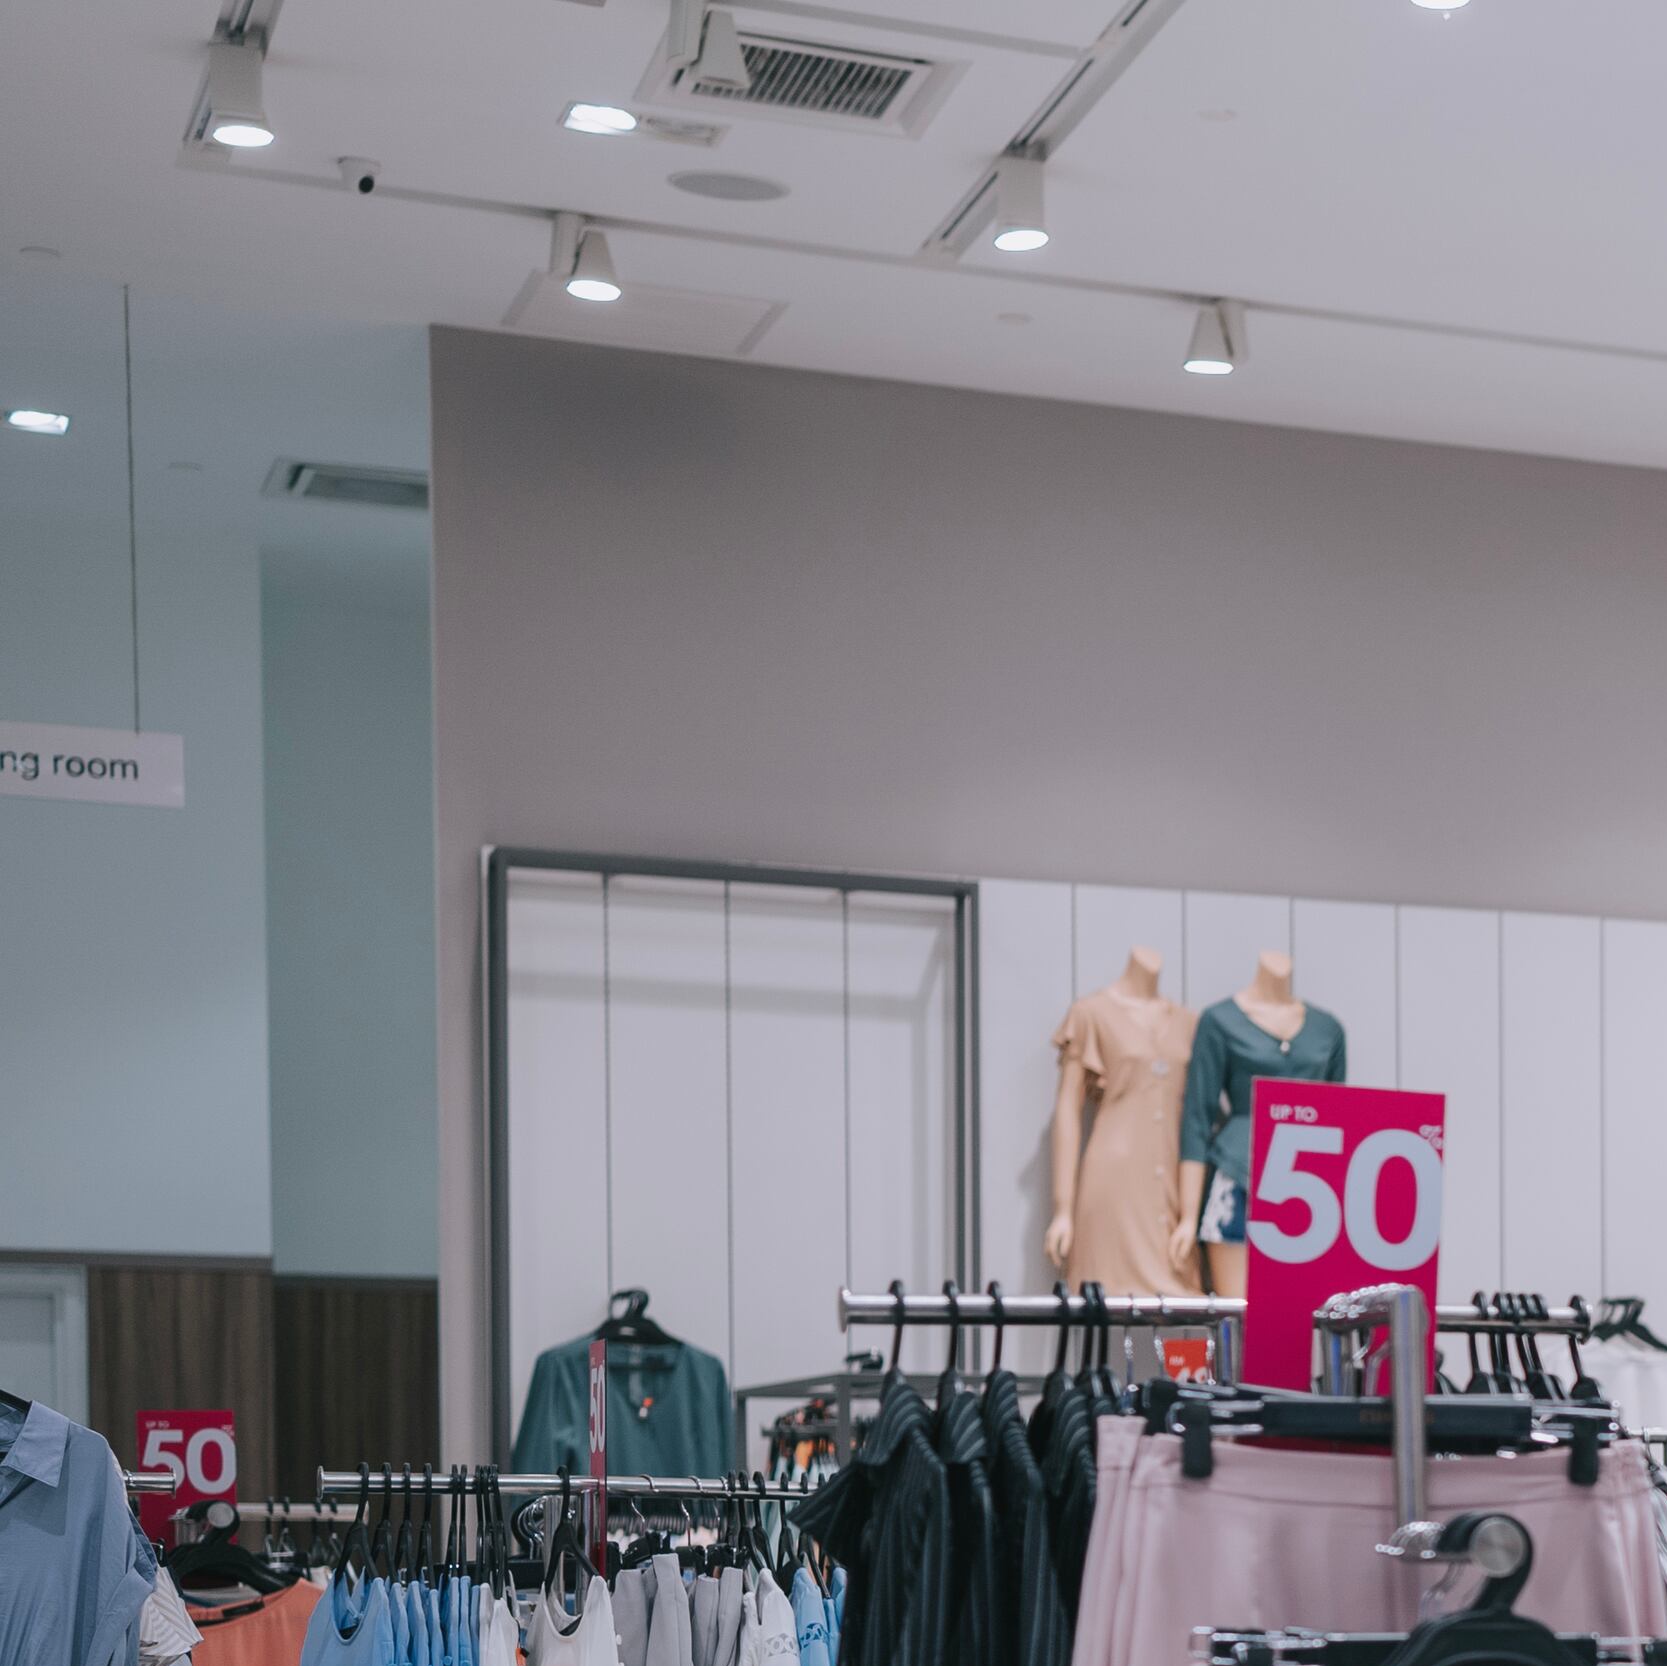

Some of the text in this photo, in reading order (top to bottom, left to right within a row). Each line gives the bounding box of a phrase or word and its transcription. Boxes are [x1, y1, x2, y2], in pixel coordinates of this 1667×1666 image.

[53, 754, 140, 781] room
[1270, 1104, 1319, 1124] UP TO
